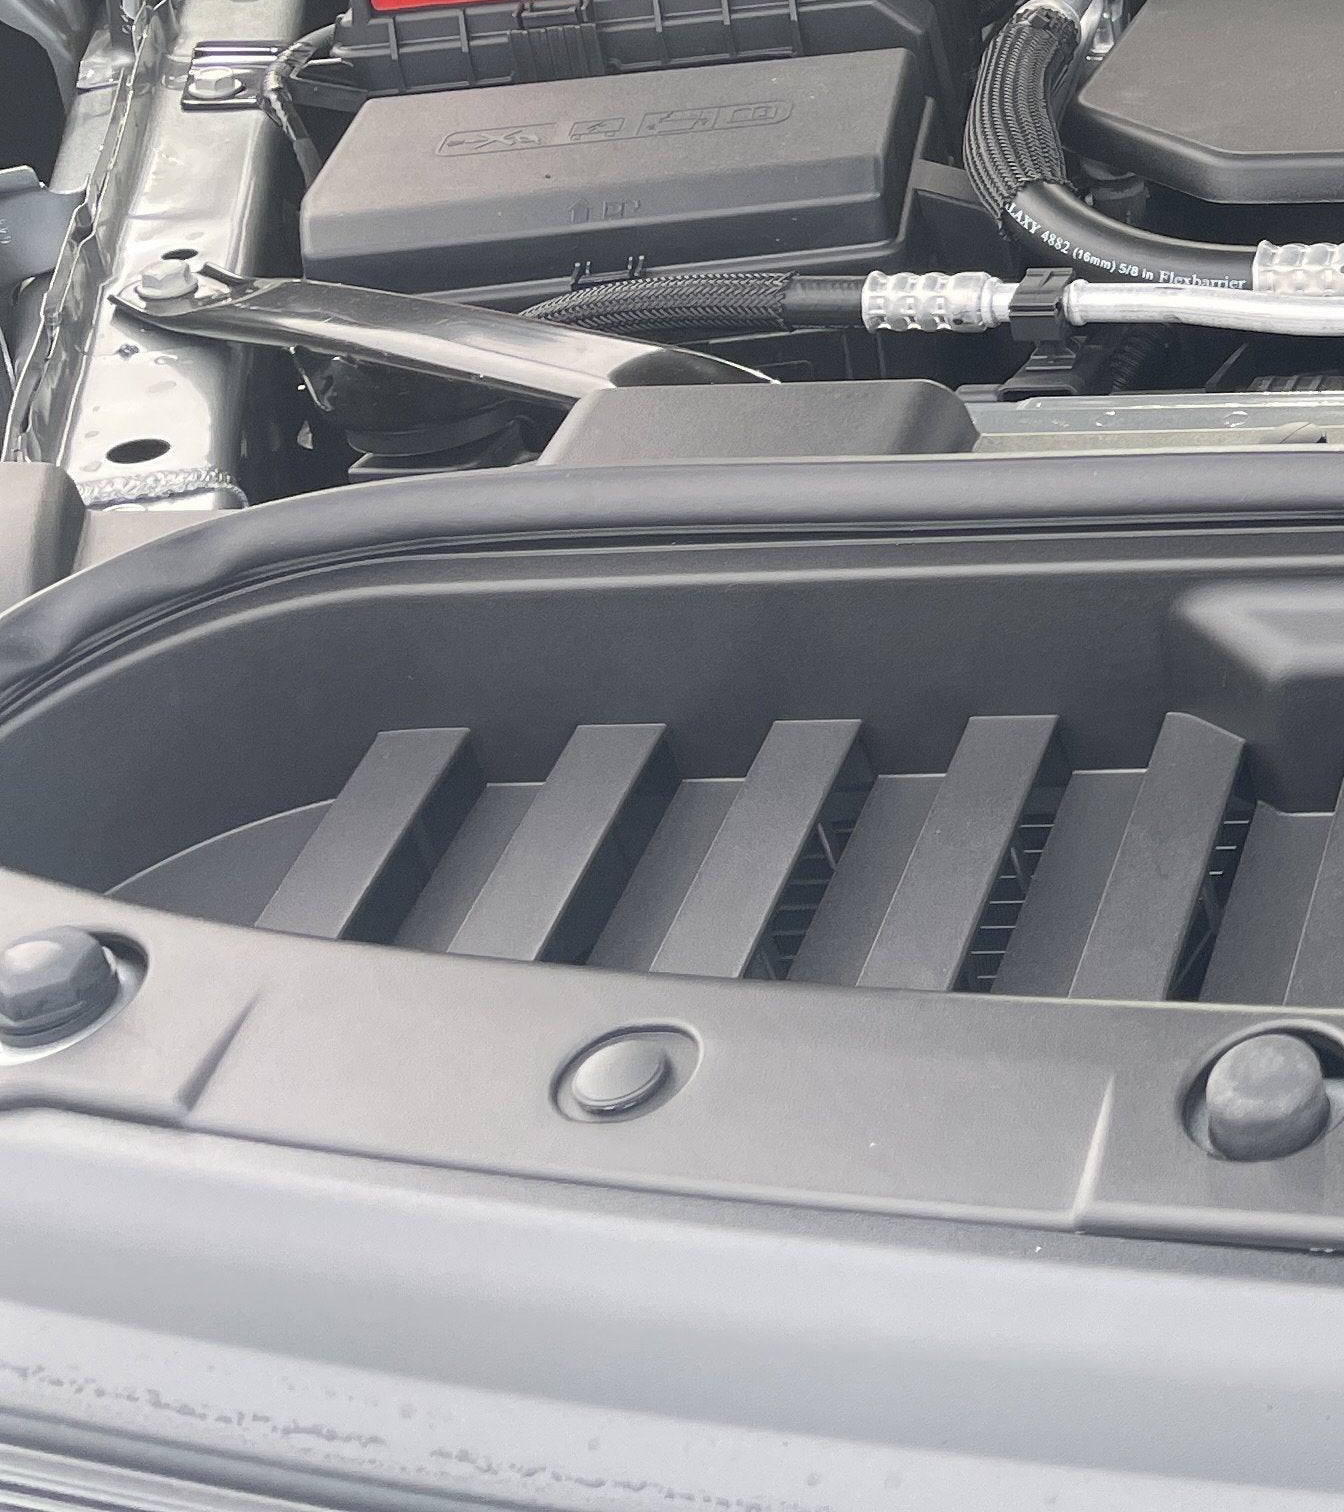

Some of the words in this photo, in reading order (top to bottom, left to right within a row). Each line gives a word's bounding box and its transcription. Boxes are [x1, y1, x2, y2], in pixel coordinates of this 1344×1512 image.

[1040, 230, 1071, 255] 4882
[1072, 247, 1116, 273] (16mm)
[1118, 262, 1139, 277] 5/8
[1158, 270, 1247, 289] Flexbarrier
